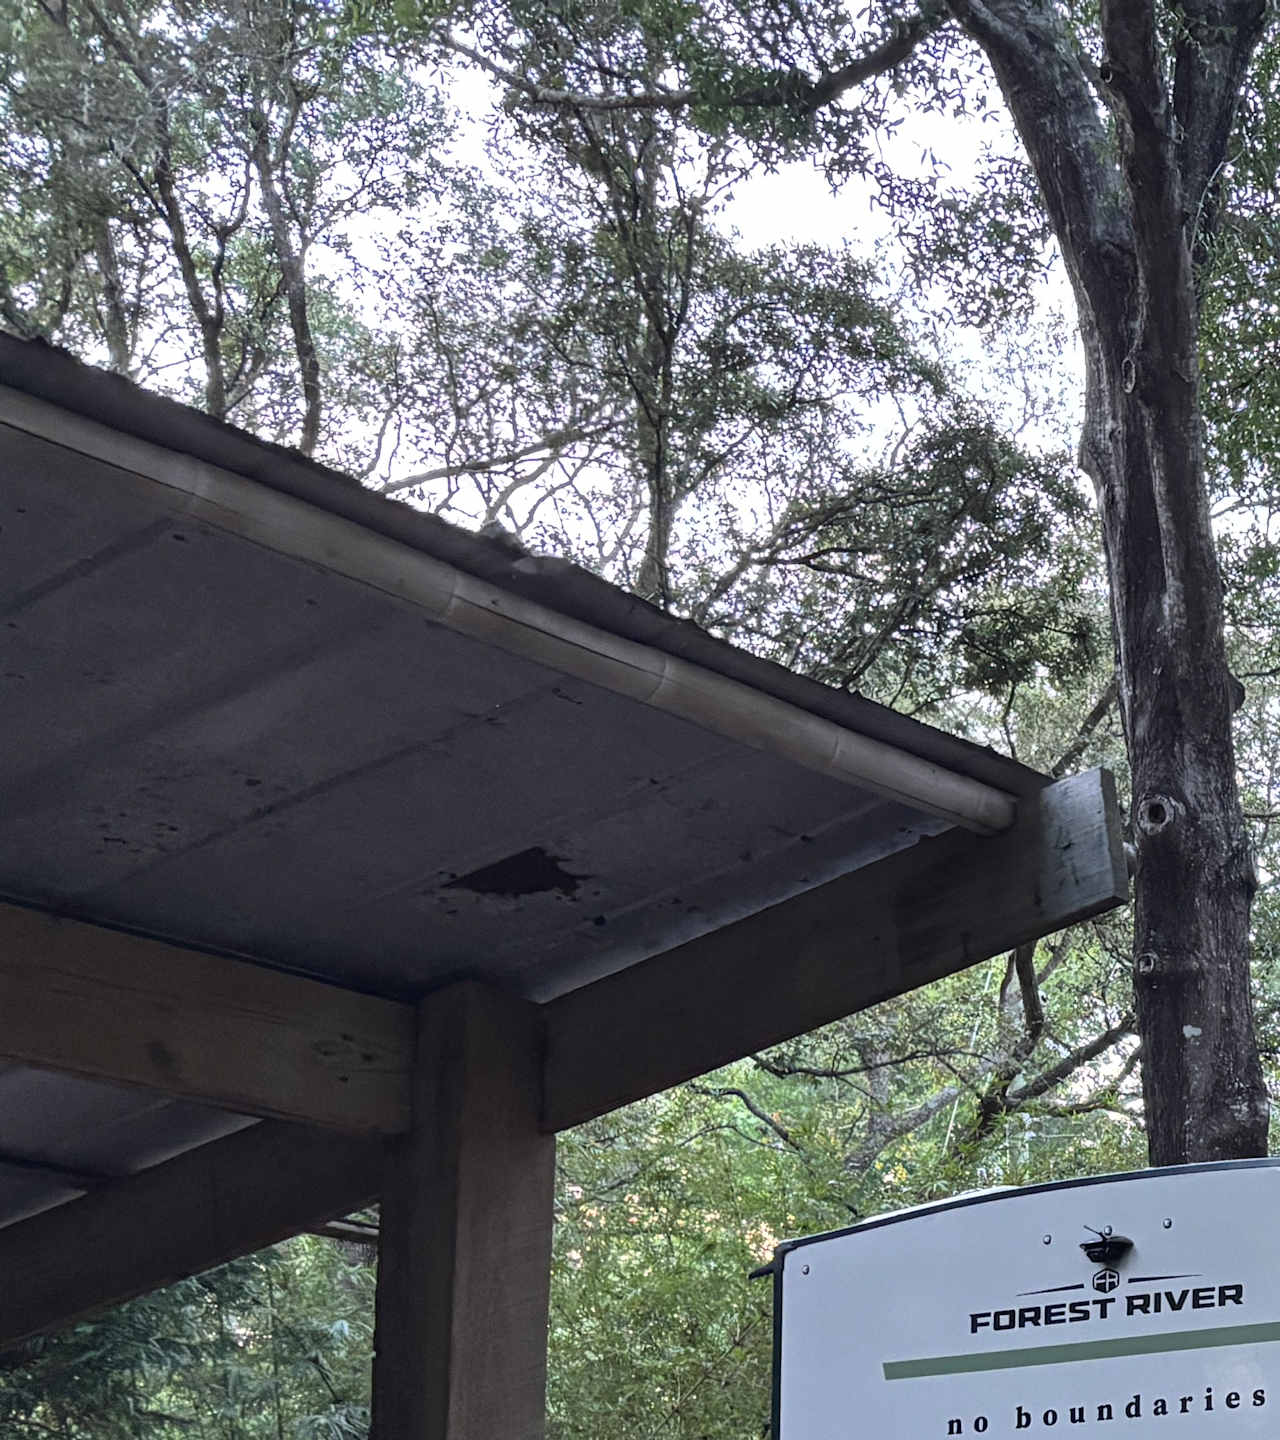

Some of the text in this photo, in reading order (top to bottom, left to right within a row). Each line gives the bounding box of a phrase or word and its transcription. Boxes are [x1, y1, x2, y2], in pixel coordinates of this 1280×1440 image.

[969, 1283, 1244, 1334] FOREST RIVER
[947, 1387, 1266, 1436] no boundaries
